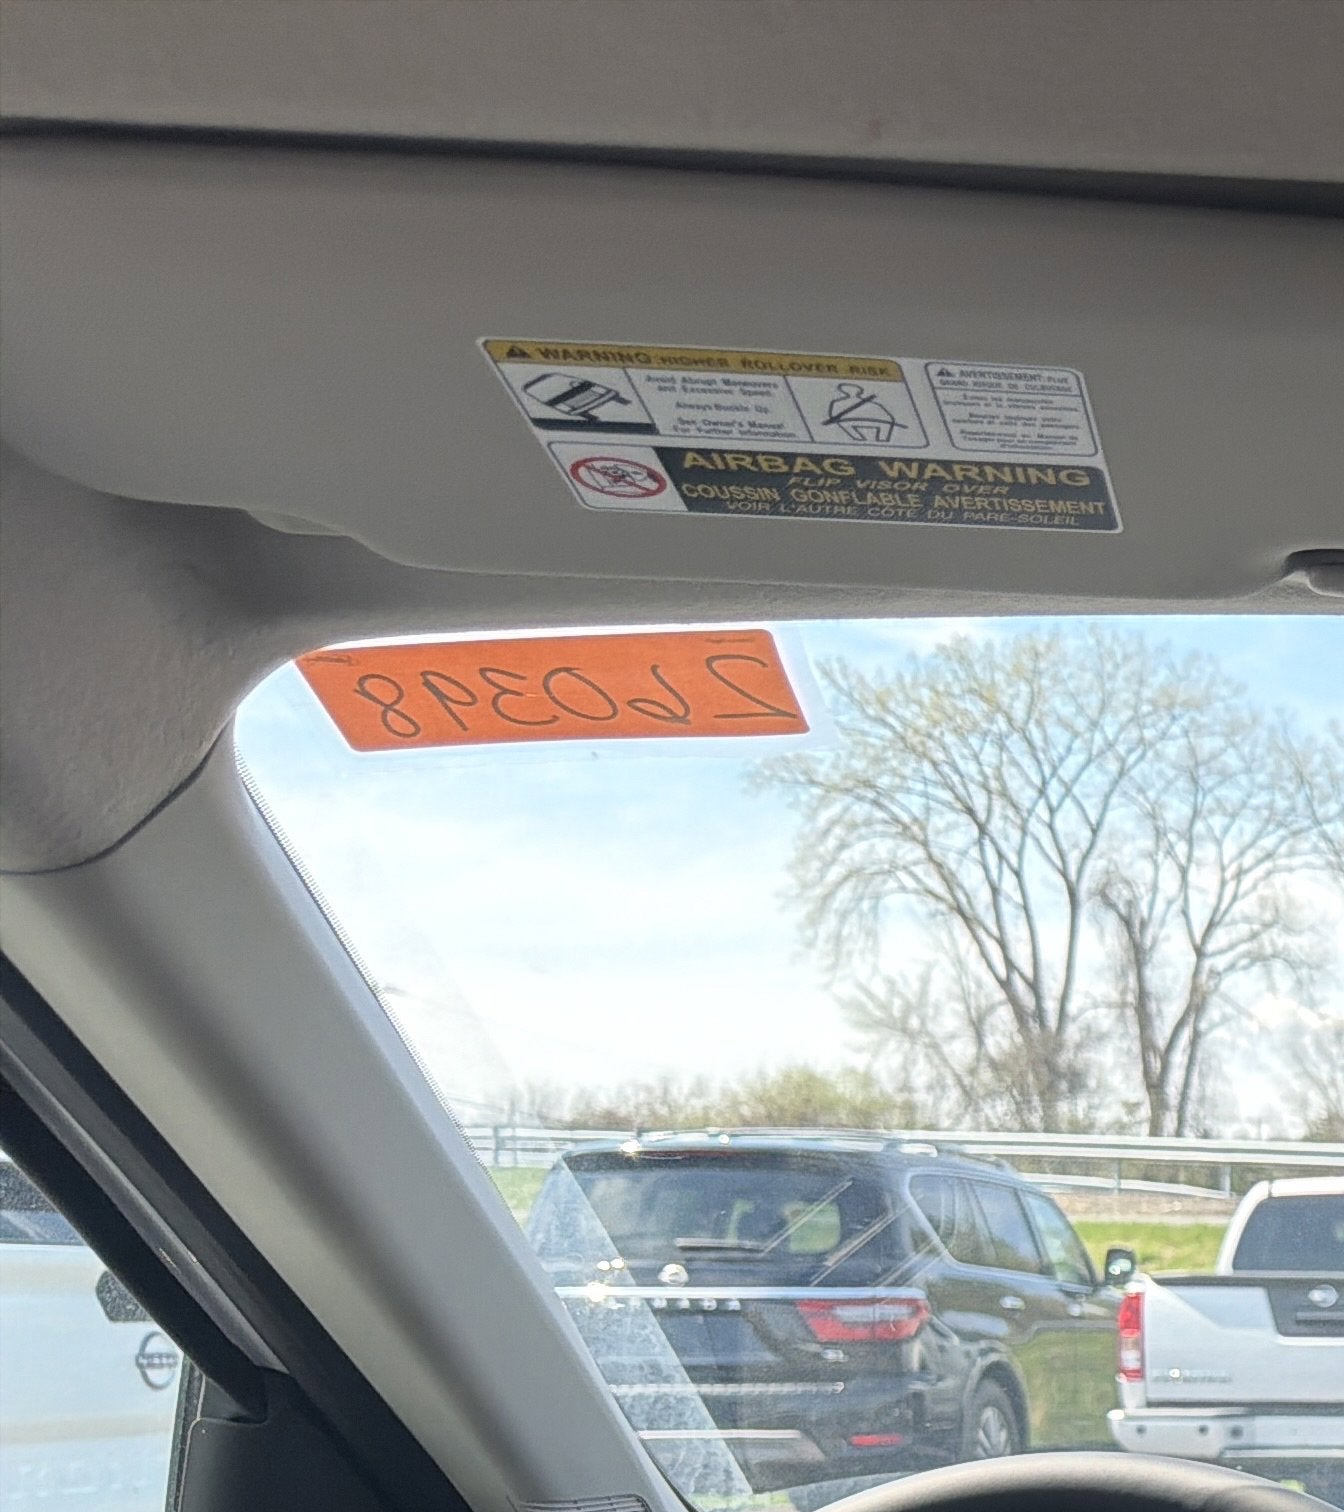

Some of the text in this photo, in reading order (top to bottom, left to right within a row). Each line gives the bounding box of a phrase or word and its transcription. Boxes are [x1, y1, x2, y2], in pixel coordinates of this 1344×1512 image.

[850, 361, 891, 376] RISK
[683, 451, 1091, 486] AIRBAG WARNING
[787, 477, 1010, 495] FLIP VISOR OVER
[681, 483, 1105, 515] COUSSIN GONFLABLE AVERTISSEMENT
[726, 501, 771, 511] VOIR
[927, 510, 953, 520] DU
[964, 511, 1080, 525] PARE-SOLEIL
